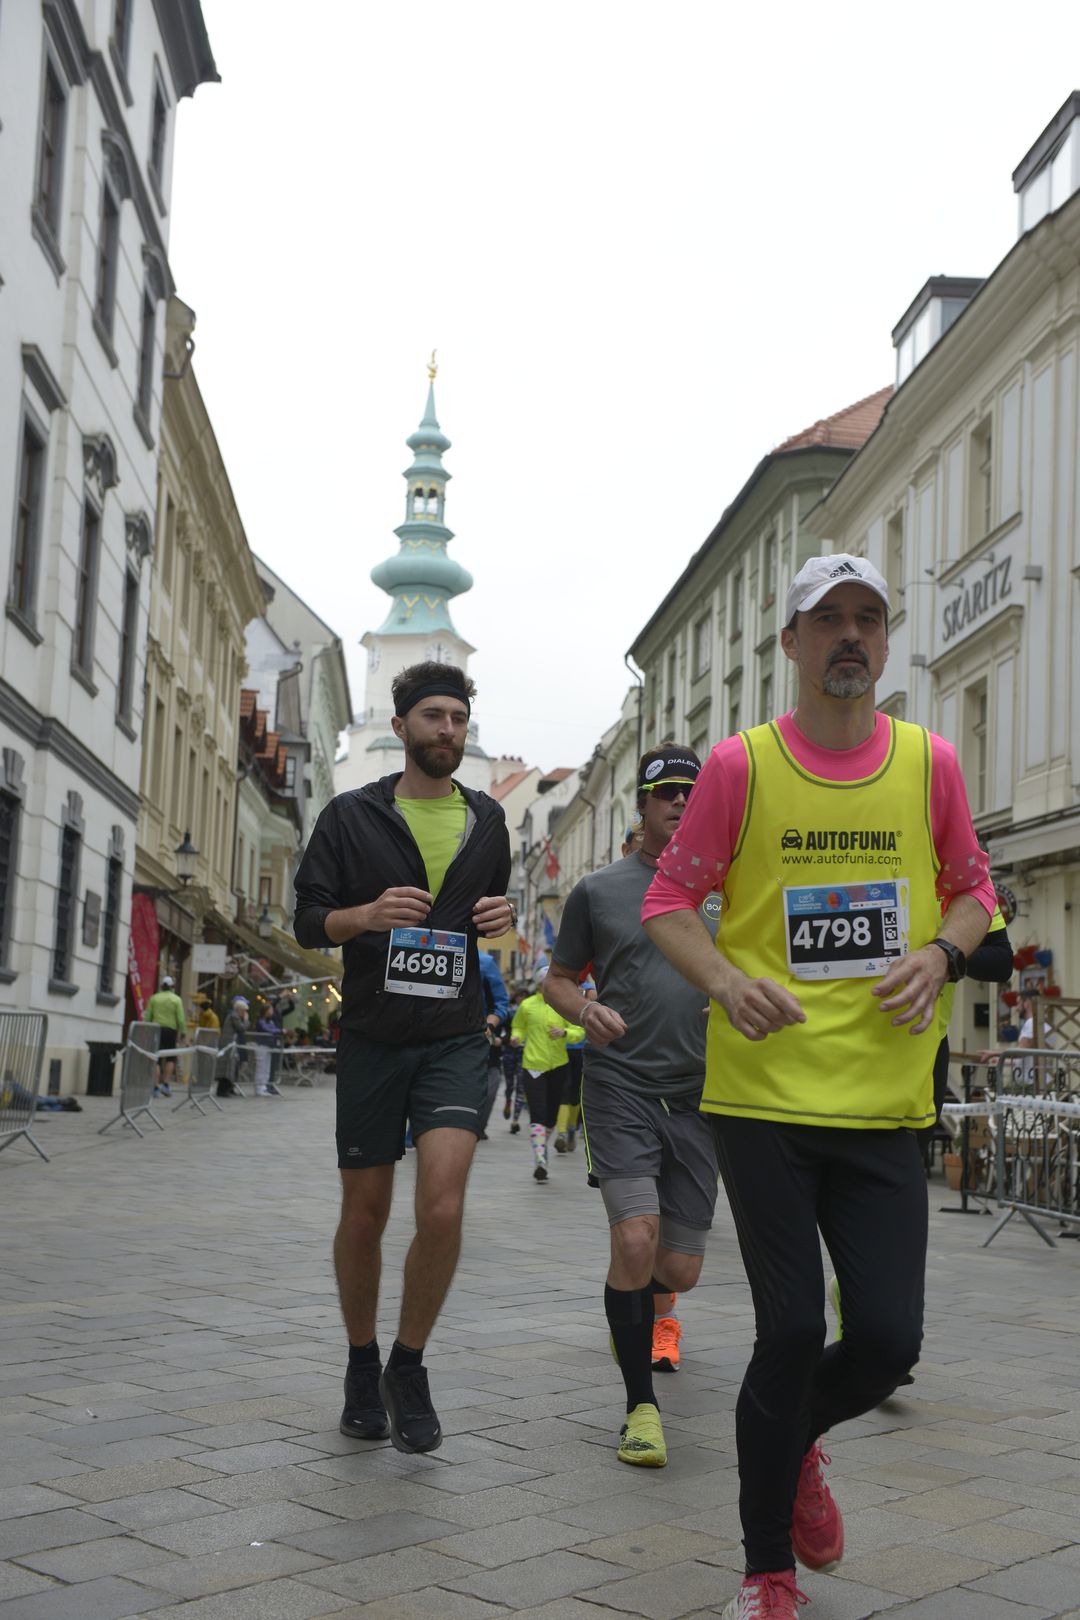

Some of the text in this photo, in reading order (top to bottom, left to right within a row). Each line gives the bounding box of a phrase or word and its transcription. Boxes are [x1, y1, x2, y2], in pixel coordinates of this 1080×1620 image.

[943, 555, 1012, 642] SKARITZ
[648, 763, 661, 775] BOA
[668, 759, 695, 768] DIALED
[805, 831, 897, 851] AUTOFUNIA
[781, 852, 902, 866] www.autofunia.com
[792, 916, 872, 950] 4798
[390, 950, 448, 977] 4698
